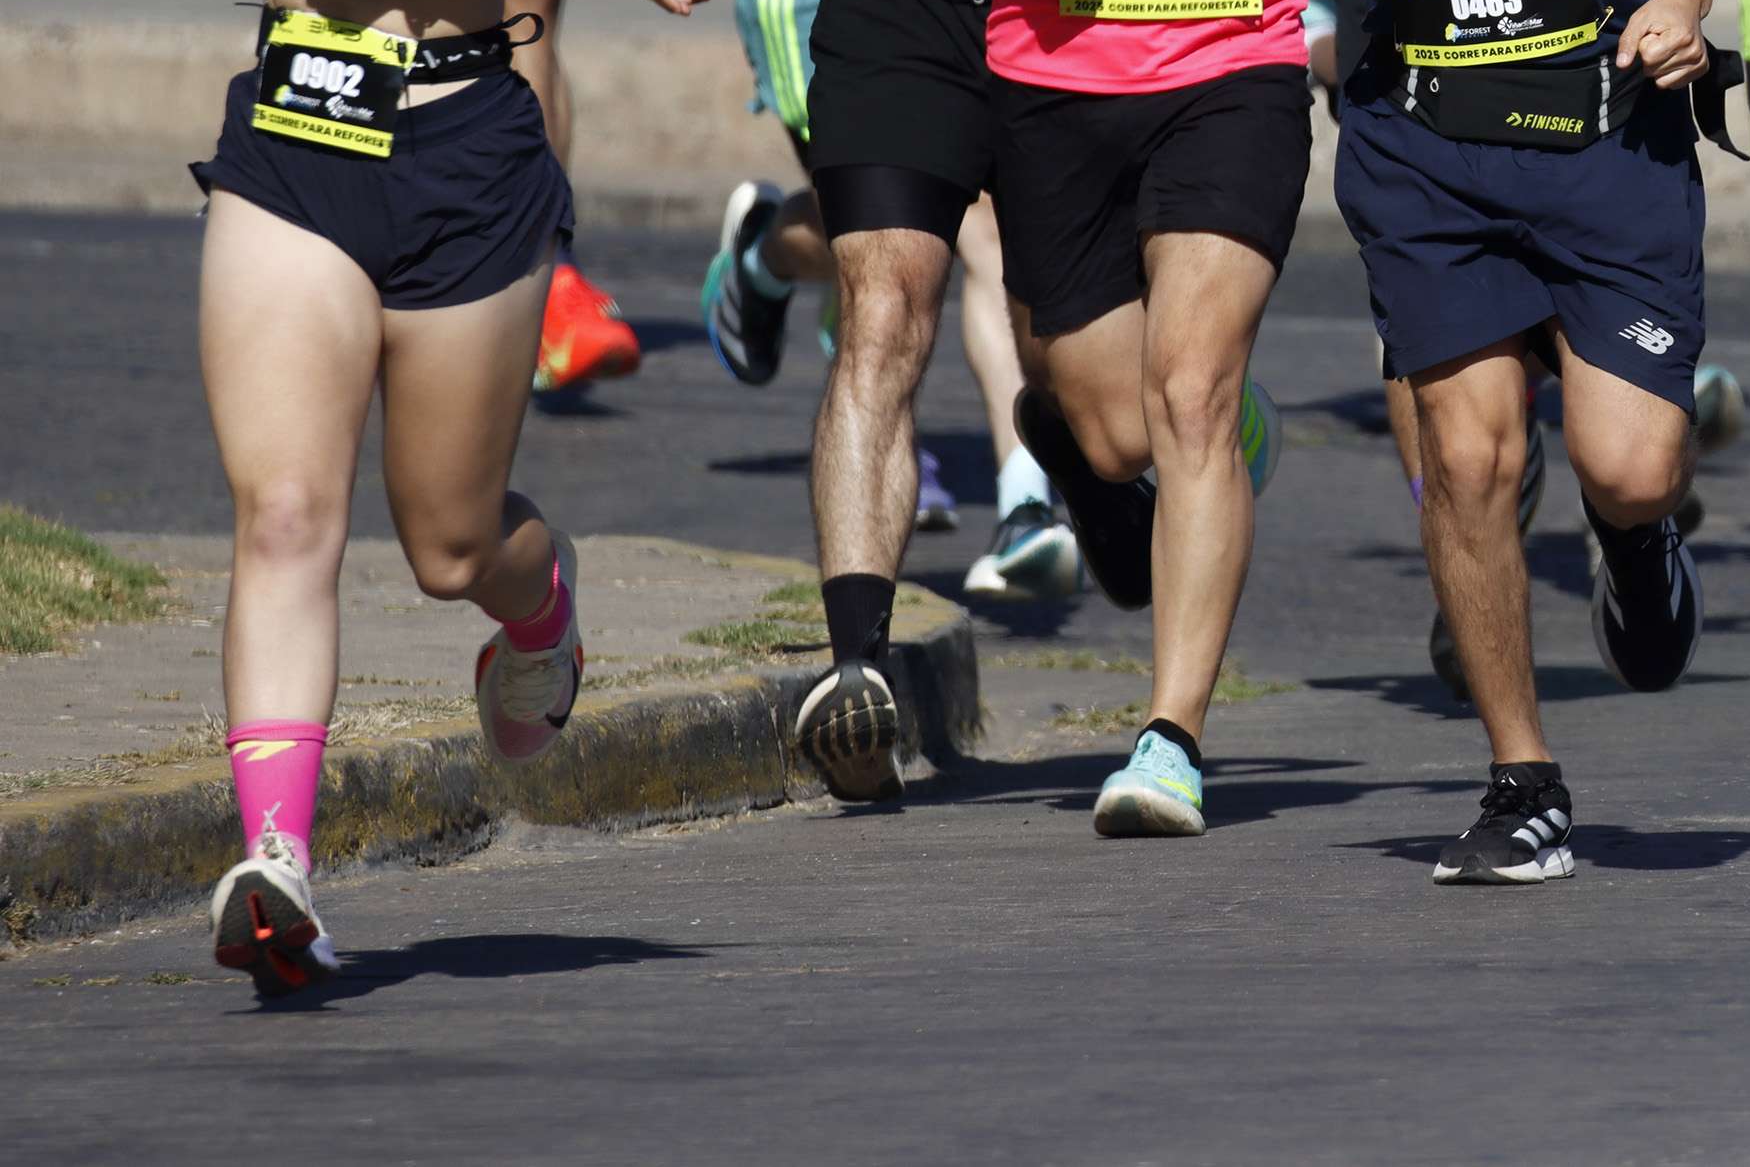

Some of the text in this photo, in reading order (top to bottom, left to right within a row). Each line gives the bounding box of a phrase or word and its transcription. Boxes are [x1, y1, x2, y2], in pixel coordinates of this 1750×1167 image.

[1074, 0, 1249, 12] 2025 CORRE PARA REFORESTAR
[1414, 31, 1585, 60] 2025 CORRE PARA REFORESTAR
[289, 52, 365, 98] 0902
[301, 121, 332, 137] PARA
[1523, 114, 1585, 133] FINISHER
